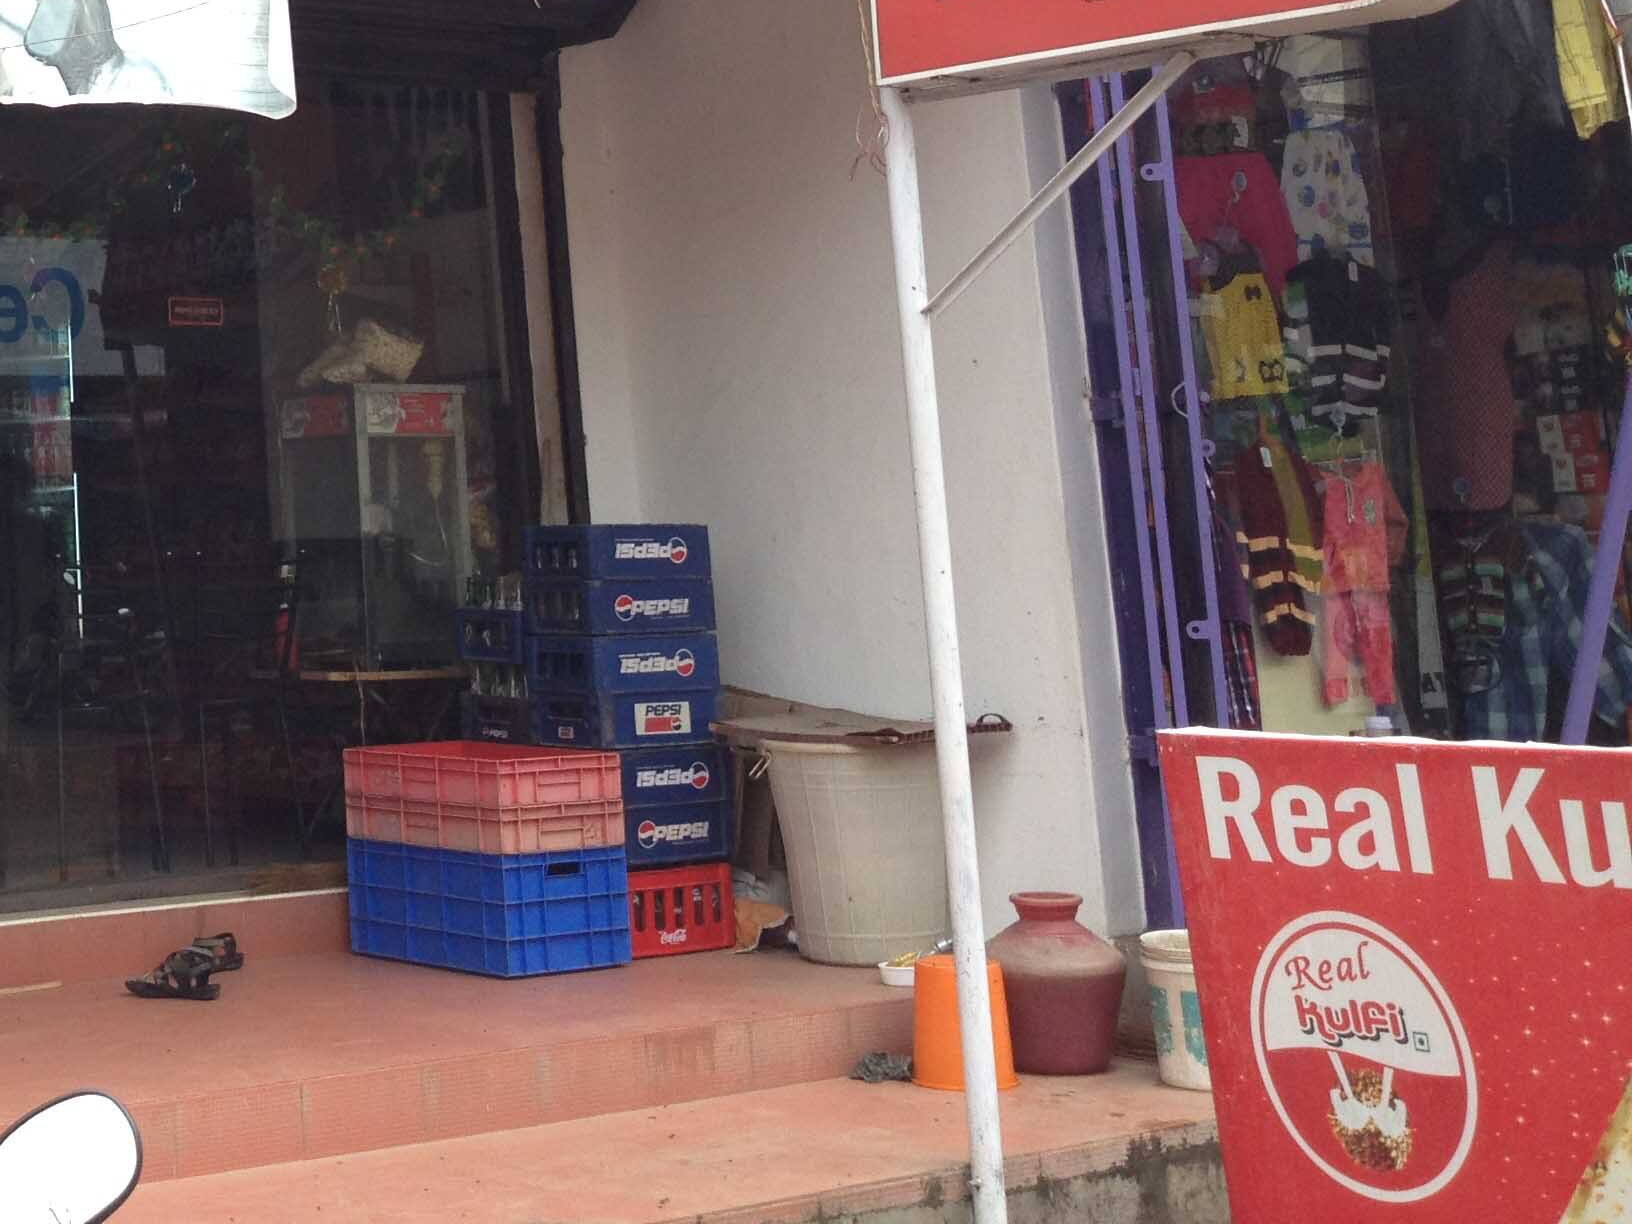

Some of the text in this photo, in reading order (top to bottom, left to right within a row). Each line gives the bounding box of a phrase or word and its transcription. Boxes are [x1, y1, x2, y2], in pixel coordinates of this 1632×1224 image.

[615, 542, 672, 559] PEPSI
[630, 598, 689, 616] PEPSI
[620, 655, 681, 674] PEPSI
[645, 703, 682, 717] PEPSI
[636, 767, 695, 788] PEPSI
[1194, 755, 1435, 875] Real
[652, 821, 710, 842] PEPSI
[1284, 941, 1371, 991] Real
